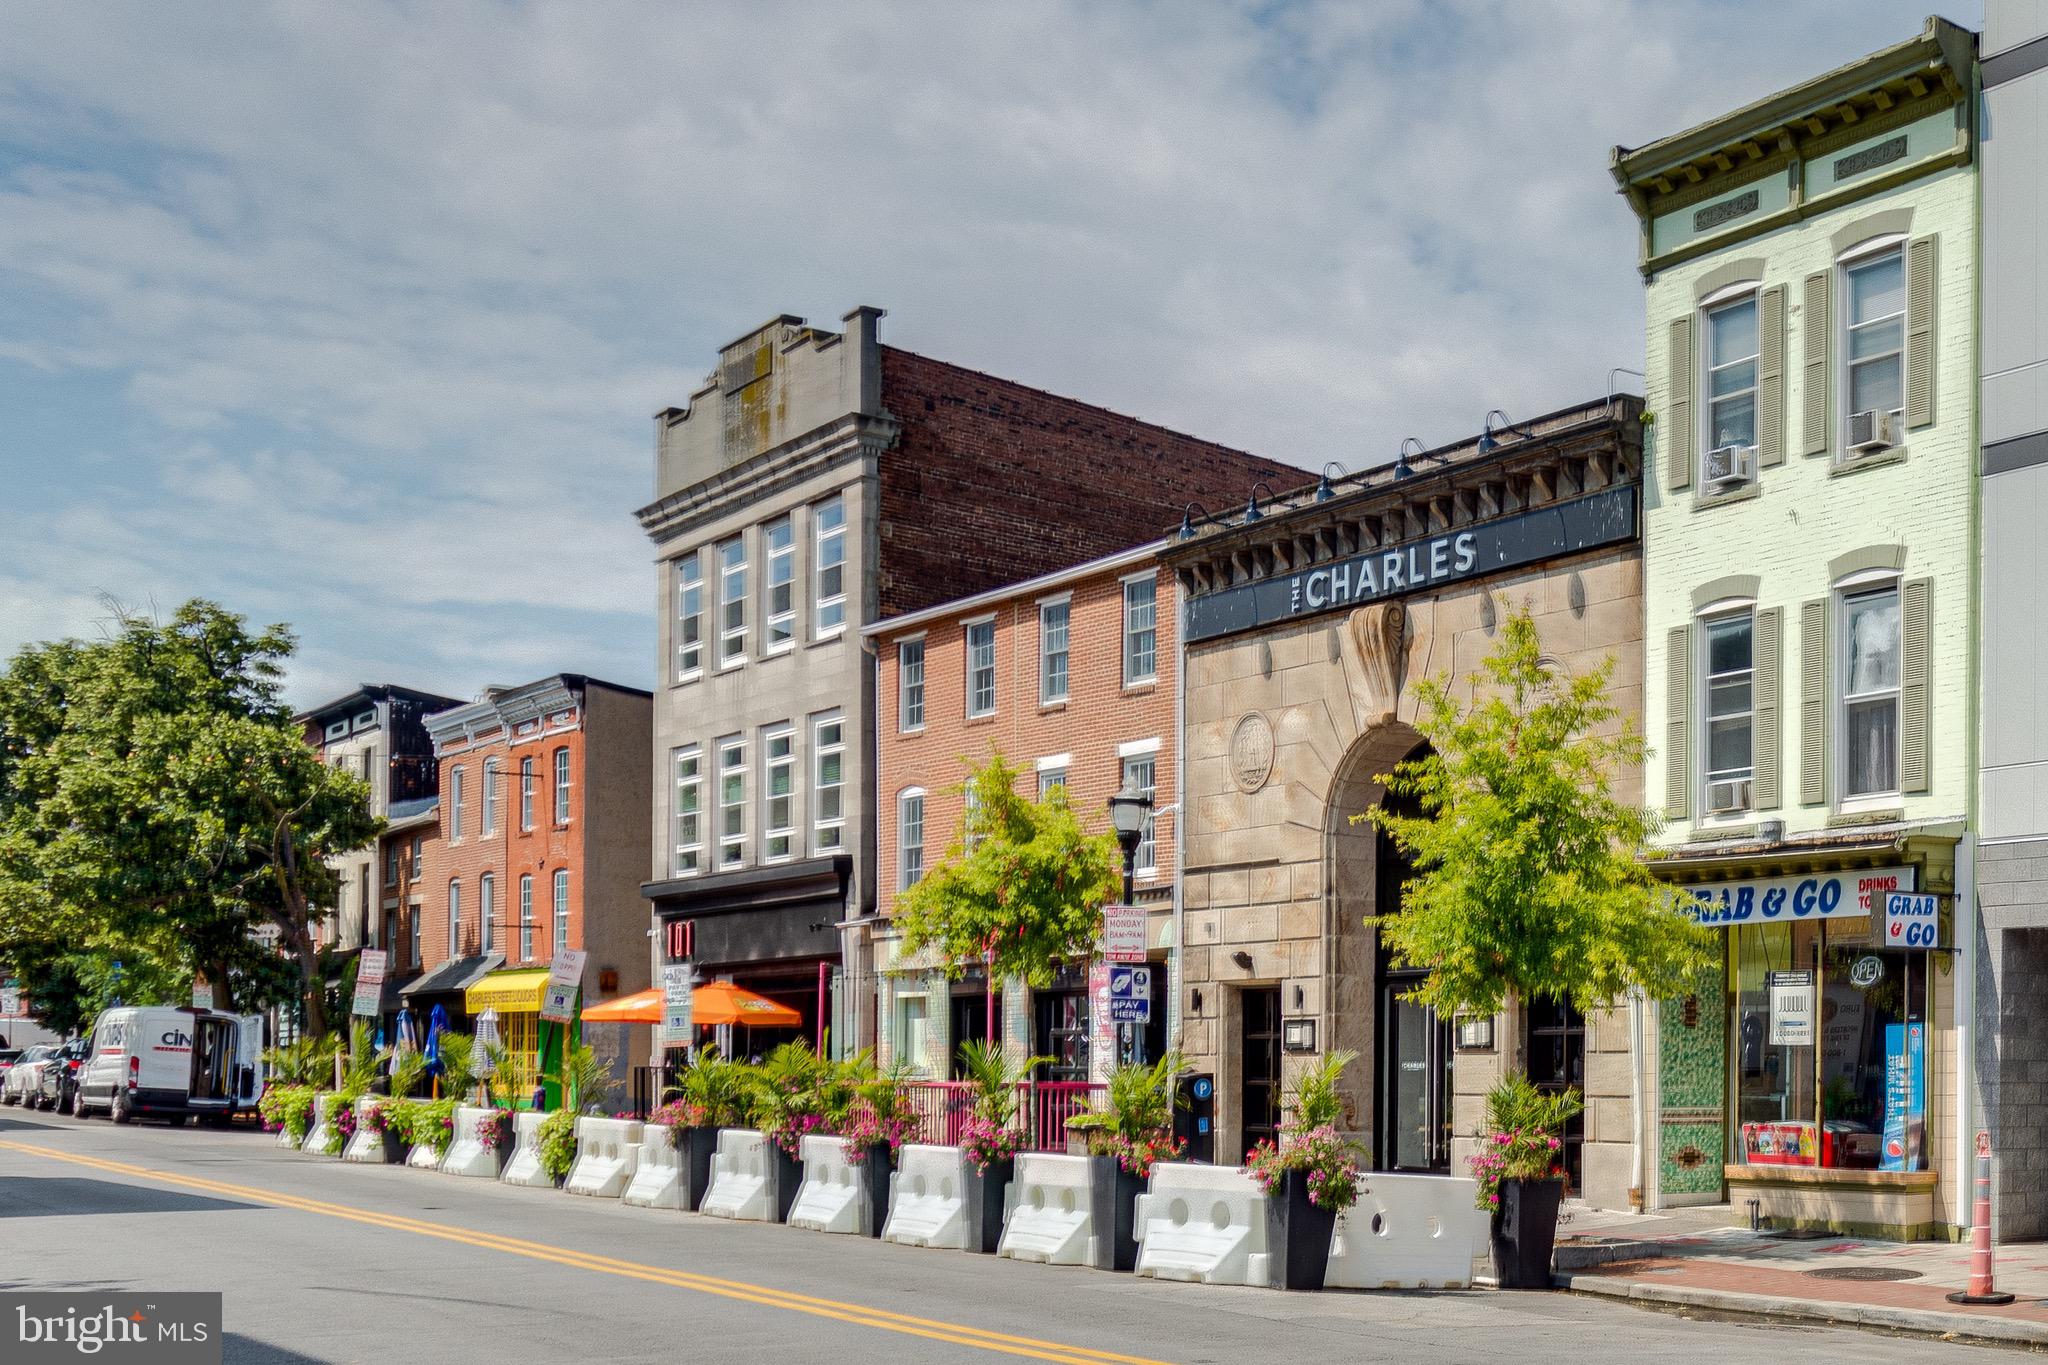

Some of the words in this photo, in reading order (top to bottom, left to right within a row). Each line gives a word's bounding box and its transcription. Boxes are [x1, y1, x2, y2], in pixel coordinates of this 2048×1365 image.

[1291, 577, 1300, 613] THE
[1306, 533, 1477, 608] CHARLES
[1858, 876, 1897, 893] DRINKS
[1762, 887, 1786, 916] &
[1793, 878, 1841, 917] GO
[1888, 895, 1934, 917] GRAB
[1109, 920, 1142, 929] MONDAY
[1890, 921, 1903, 937] &
[1906, 922, 1935, 946] GO
[667, 920, 695, 957] 101
[563, 952, 576, 961] NO
[1136, 971, 1144, 981] 4
[1851, 960, 1884, 980] OPEN
[1119, 1001, 1139, 1009] PAY
[1114, 1010, 1143, 1019] HERE
